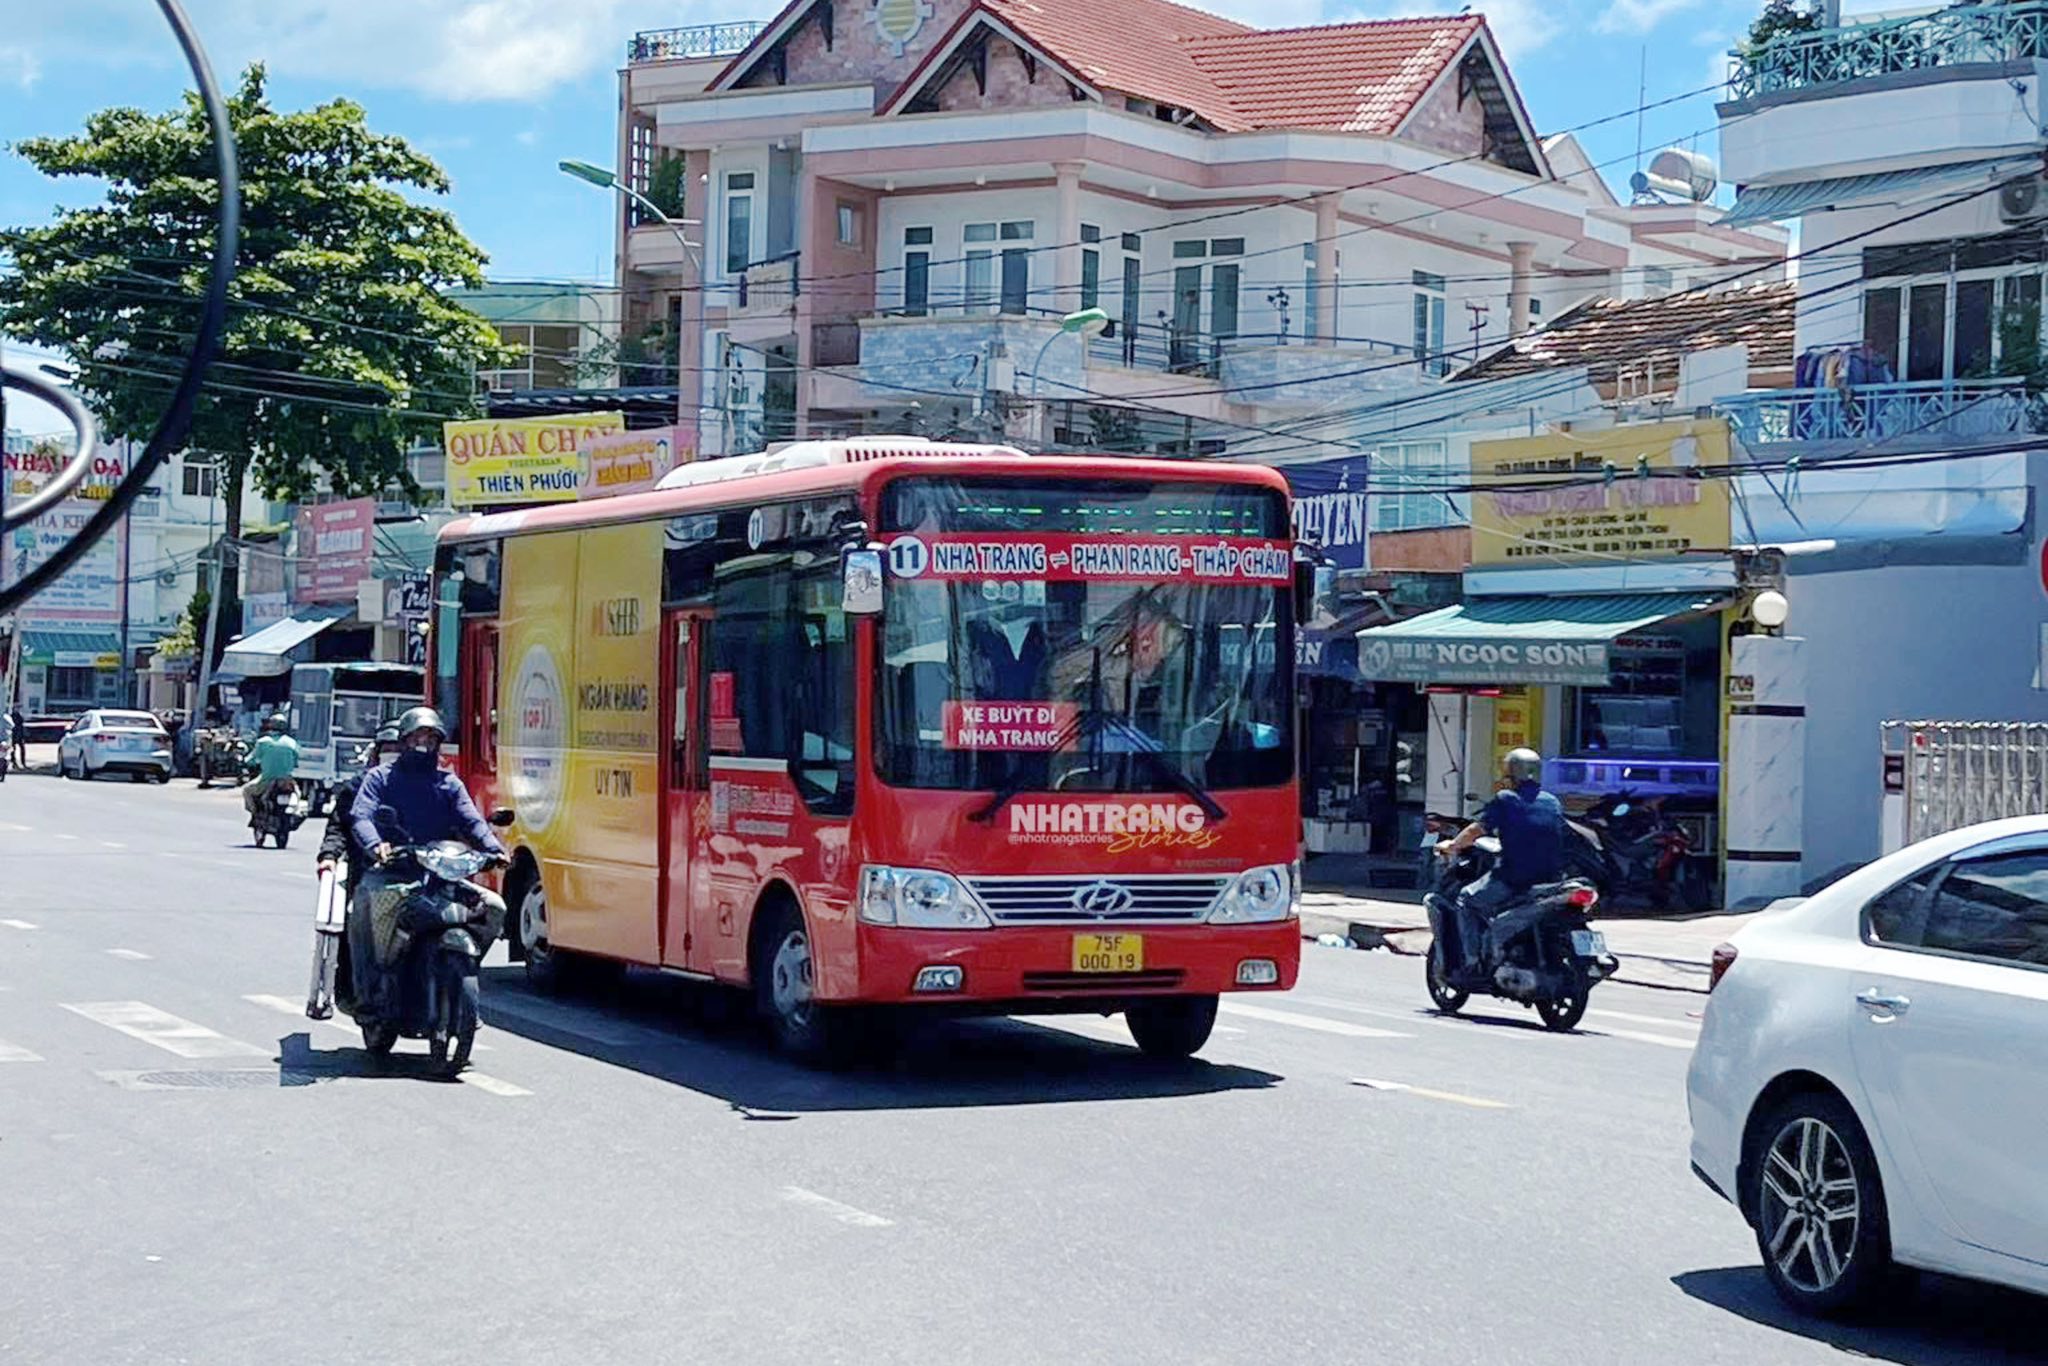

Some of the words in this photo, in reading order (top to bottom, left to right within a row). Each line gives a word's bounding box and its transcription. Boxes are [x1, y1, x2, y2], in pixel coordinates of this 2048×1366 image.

[450, 424, 526, 465] QUÁN
[538, 425, 619, 454] CH
[4, 453, 54, 473] NHA
[891, 544, 920, 570] 11
[932, 543, 977, 573] NHA
[979, 543, 1047, 574] TRANG
[1071, 543, 1126, 574] PHAN
[1129, 546, 1181, 575] RANG
[1191, 541, 1239, 577] THÁP
[607, 598, 640, 636] SHB
[1437, 643, 1520, 671] NGỌC
[1526, 642, 1587, 667] SƠN
[961, 706, 985, 723] XE
[988, 705, 1035, 724] BUÝT
[1037, 706, 1056, 724] ĐI
[958, 729, 998, 746] NHA
[1001, 729, 1059, 747] TRANG
[1010, 803, 1205, 833] NHATRANG
[1008, 833, 1114, 846] @nhatrangstories
[1107, 811, 1222, 853] Stories
[1094, 935, 1123, 951] 75F
